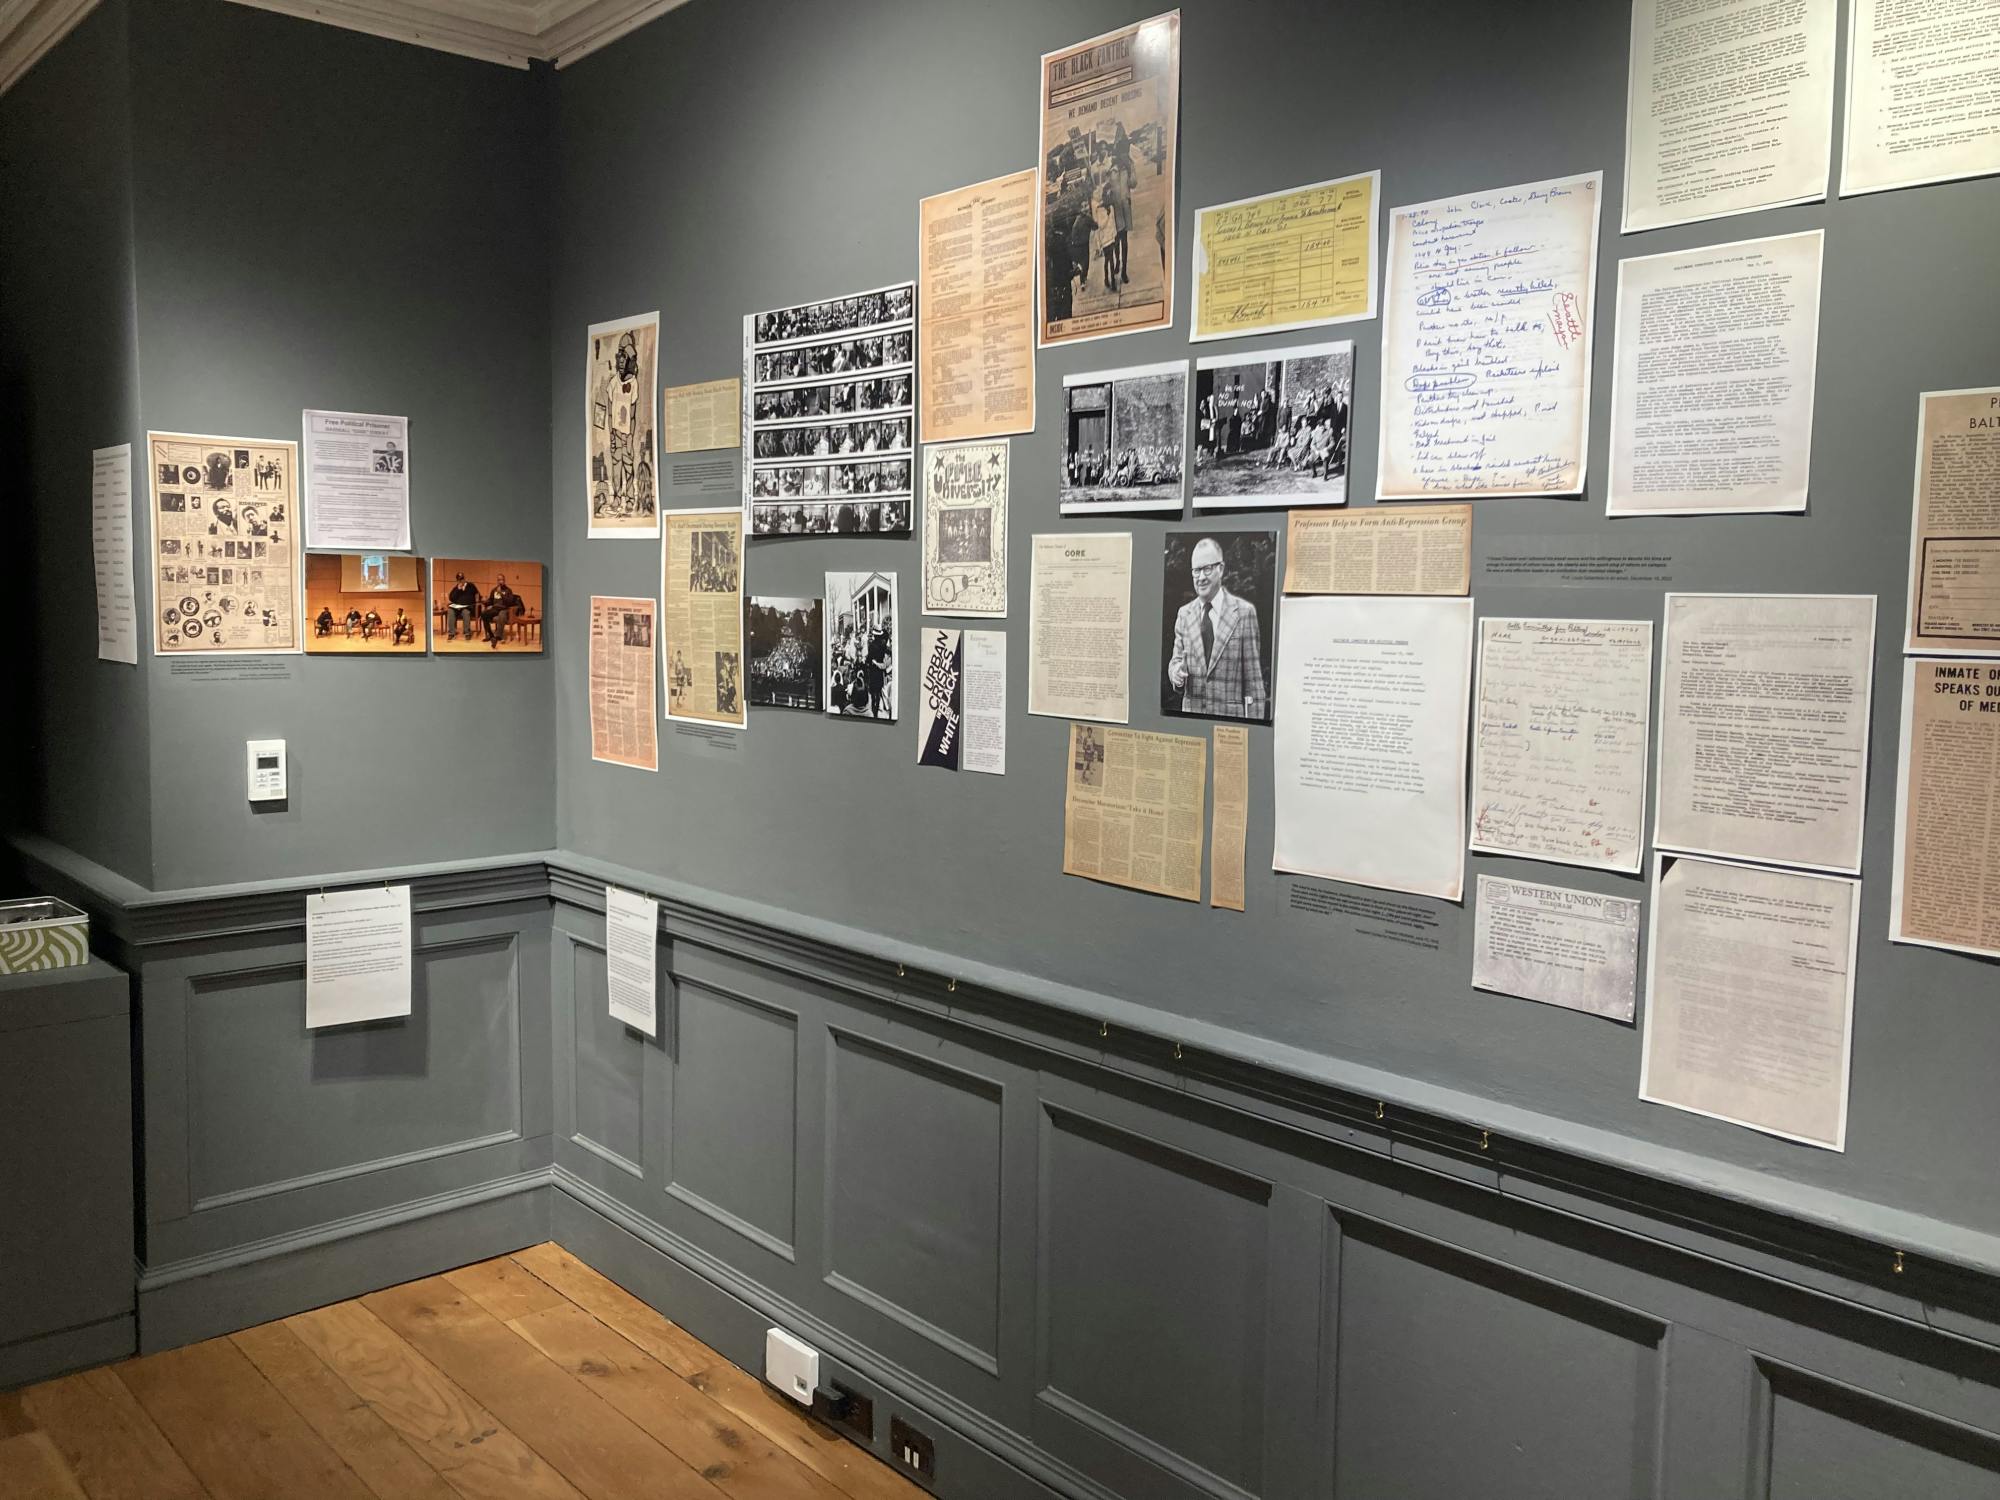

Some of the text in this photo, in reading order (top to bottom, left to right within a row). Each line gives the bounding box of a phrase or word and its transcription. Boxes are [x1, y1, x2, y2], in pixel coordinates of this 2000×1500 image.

[1053, 61, 1067, 81] THE
[1071, 50, 1093, 76] BLACK
[1068, 108, 1076, 119] WE
[1078, 101, 1098, 117] DEMAND
[1294, 519, 1330, 530] Professors
[1331, 519, 1349, 529] Help
[1350, 519, 1357, 527] to
[1360, 519, 1380, 527] Form
[1442, 515, 1468, 527] Group
[1064, 550, 1086, 558] CORE
[923, 630, 949, 692] URBAN
[929, 649, 953, 711] CRISES
[1935, 666, 1980, 679] INMATE
[939, 668, 960, 720] BLACK
[1934, 682, 1980, 695] SPEAKS
[1959, 699, 1974, 711] OF
[938, 713, 960, 756] WHITE
[1511, 885, 1603, 908] WESTERN UNION
[1538, 899, 1573, 911] TELEGRAM
